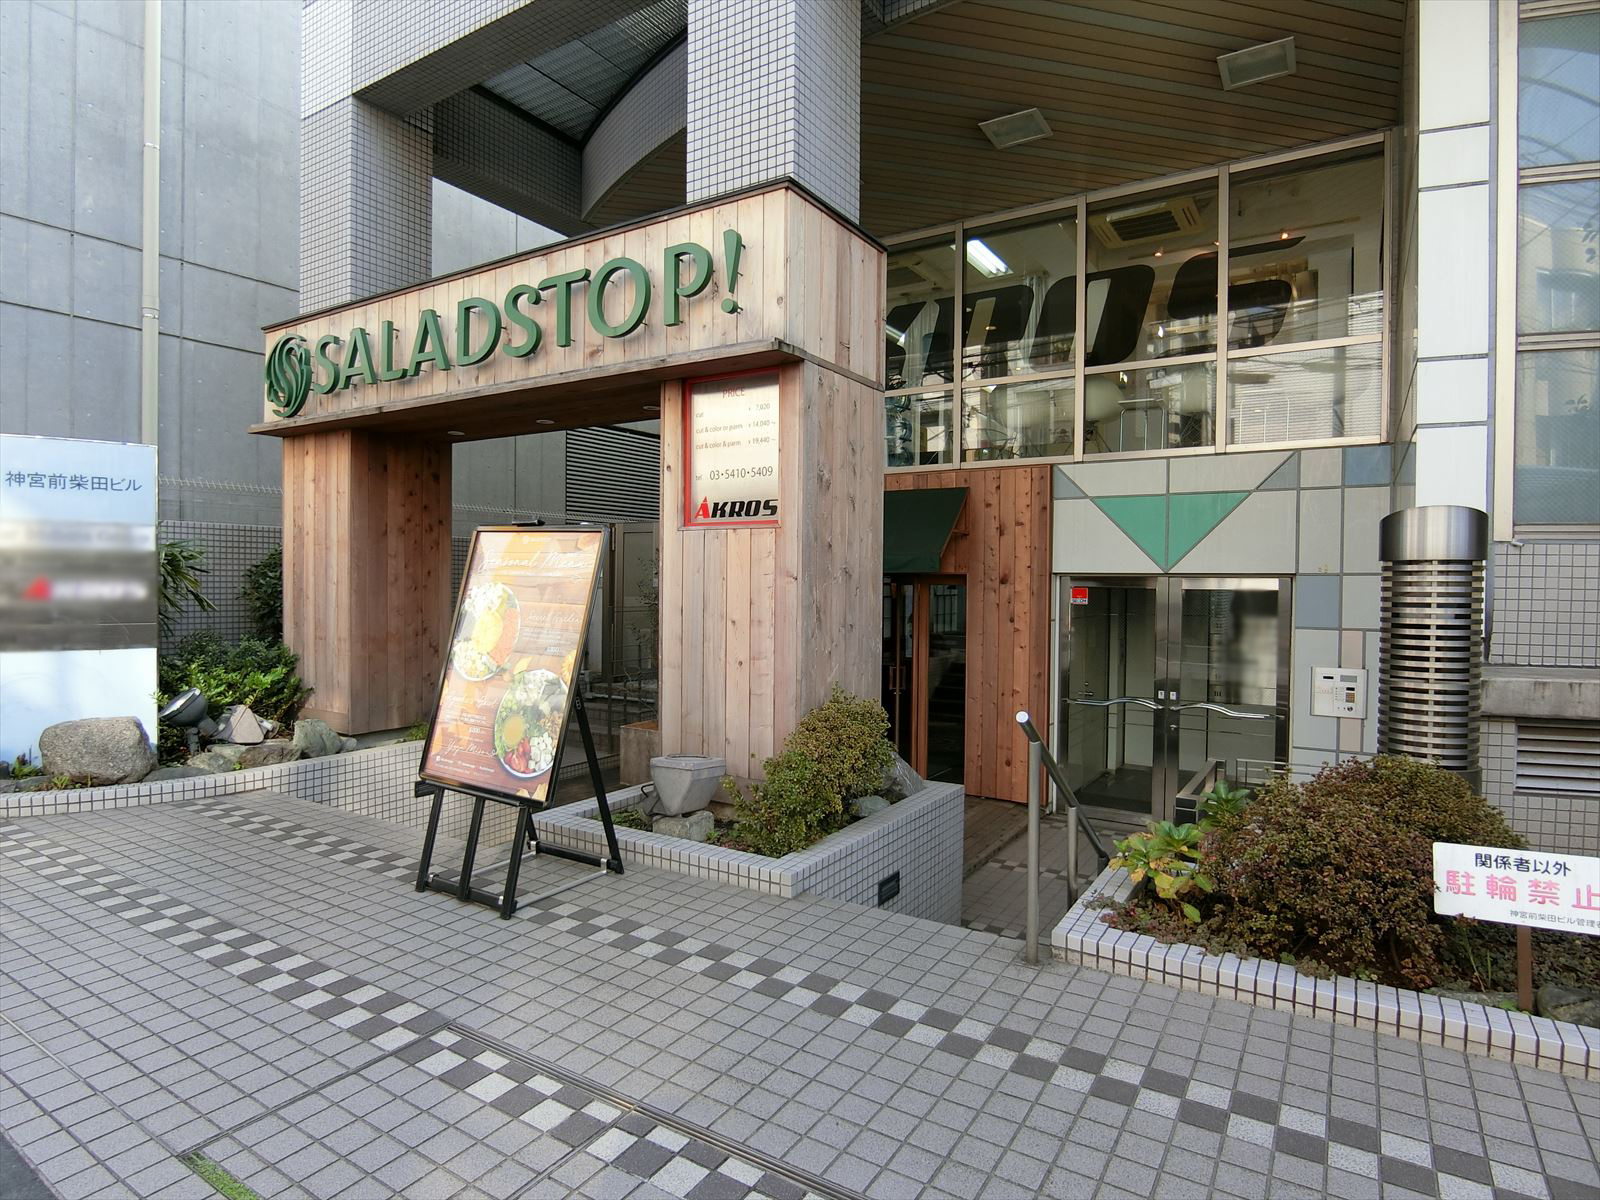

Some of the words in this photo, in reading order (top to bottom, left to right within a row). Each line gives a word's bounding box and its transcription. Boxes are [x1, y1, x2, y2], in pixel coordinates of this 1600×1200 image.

[313, 229, 743, 396] SALADSTOP!
[722, 386, 745, 399] PRICE
[709, 425, 722, 433] color
[5, 470, 143, 492] 神宮前柴田ビル
[694, 496, 779, 519] AKROS
[1474, 852, 1572, 877] 関係者以外
[1445, 870, 1600, 911] 駐輪禁止
